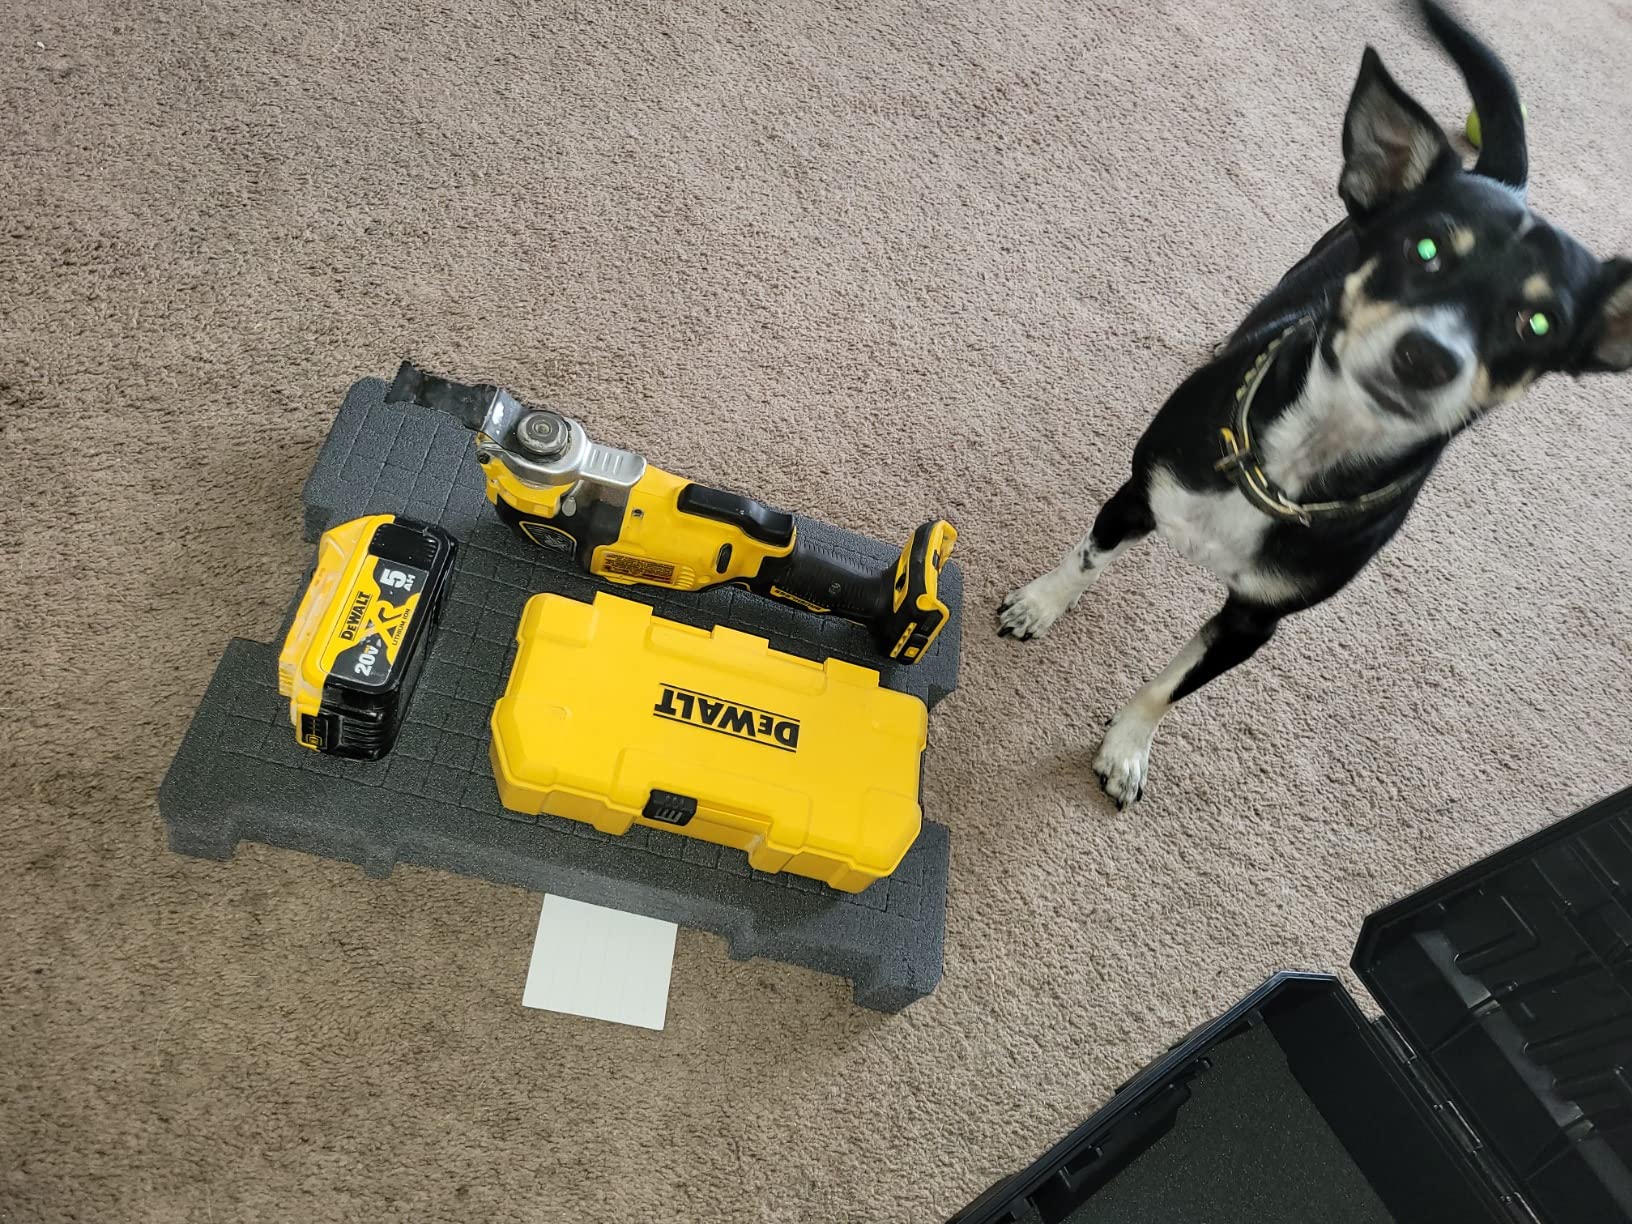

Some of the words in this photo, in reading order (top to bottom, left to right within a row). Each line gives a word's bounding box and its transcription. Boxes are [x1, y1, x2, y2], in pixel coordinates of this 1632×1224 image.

[380, 568, 407, 588] 5
[391, 620, 407, 646] LITHIUM
[402, 608, 411, 620] ION
